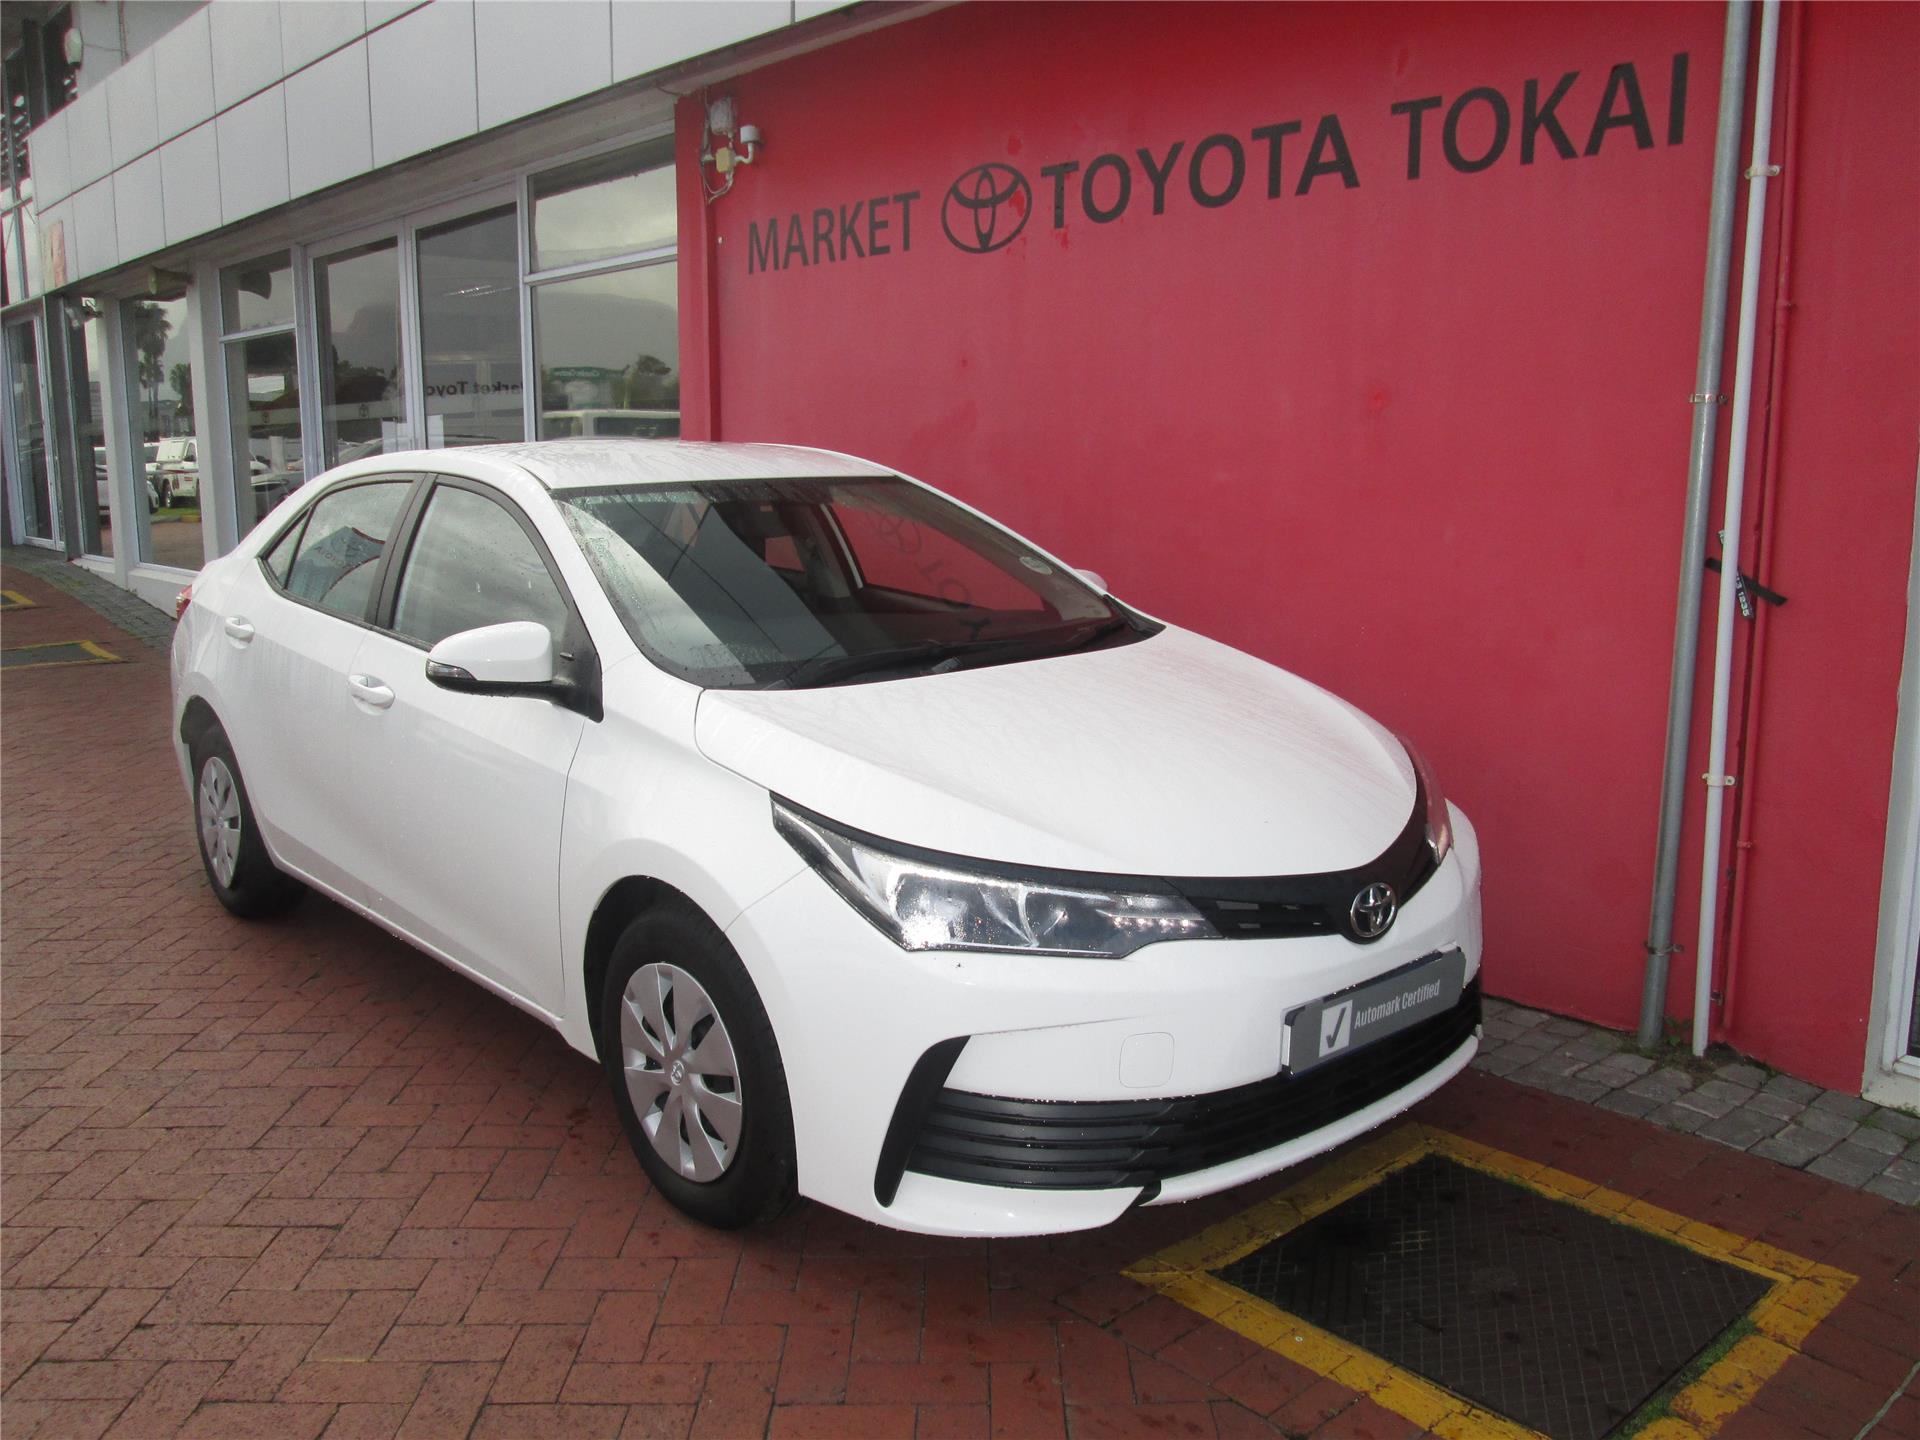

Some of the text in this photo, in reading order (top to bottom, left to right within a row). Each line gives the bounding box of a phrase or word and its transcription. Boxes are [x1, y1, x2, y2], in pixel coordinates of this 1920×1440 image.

[748, 52, 1690, 274] MARKET TOYOTA TOKAI
[1354, 979, 1441, 1030] Automark Certified
